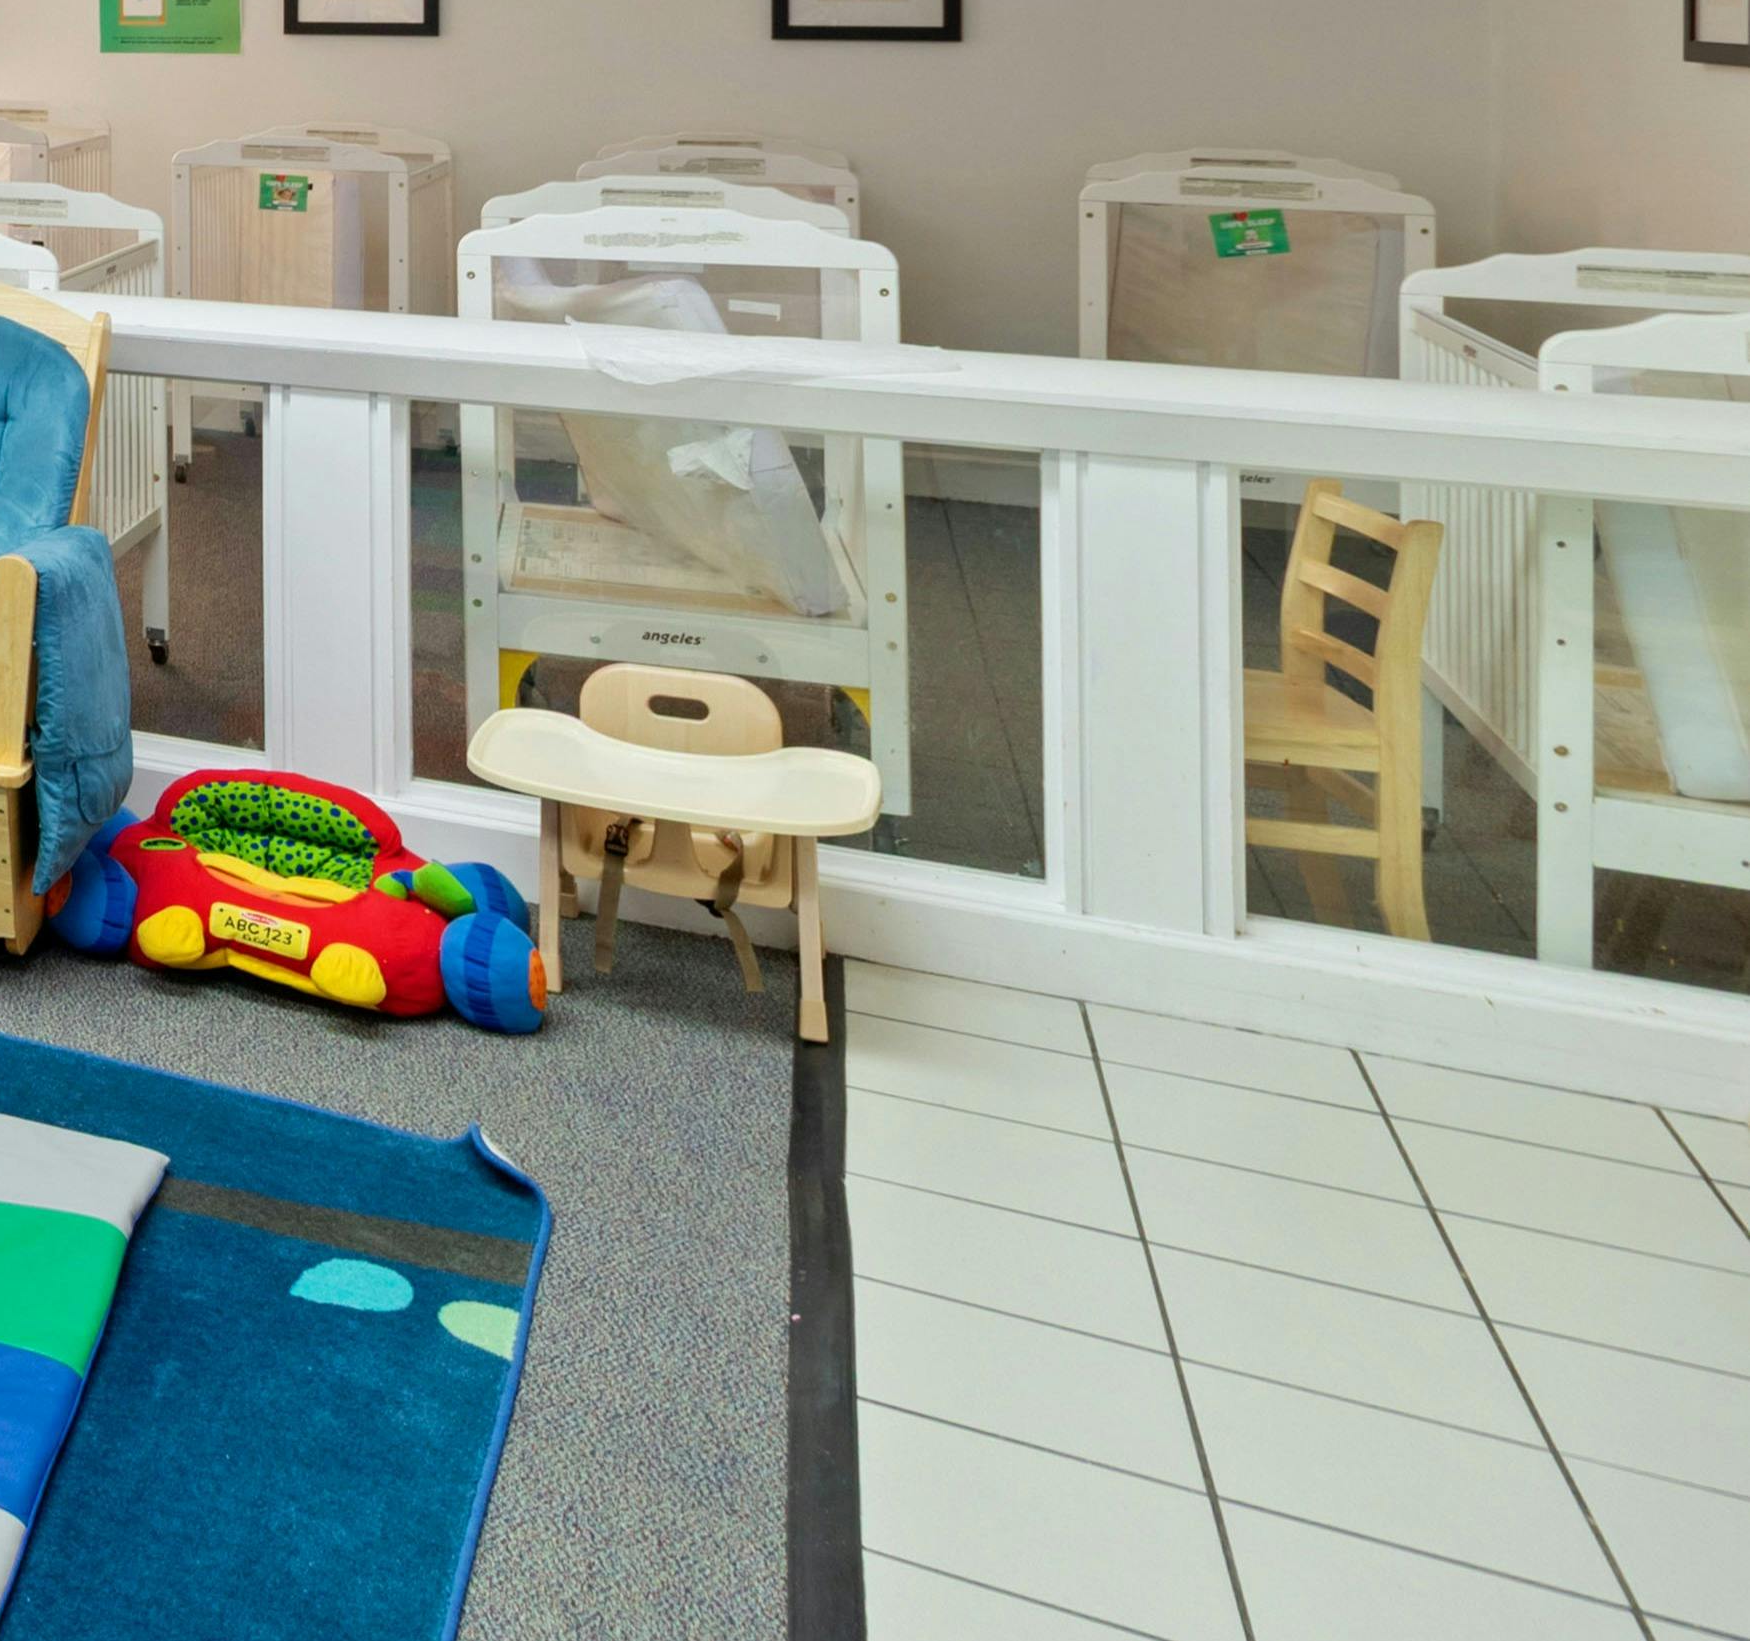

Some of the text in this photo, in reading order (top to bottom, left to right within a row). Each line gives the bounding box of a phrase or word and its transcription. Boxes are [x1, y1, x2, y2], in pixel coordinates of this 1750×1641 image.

[642, 631, 702, 646] angeles
[224, 916, 260, 935] ABC
[263, 927, 293, 946] 123
